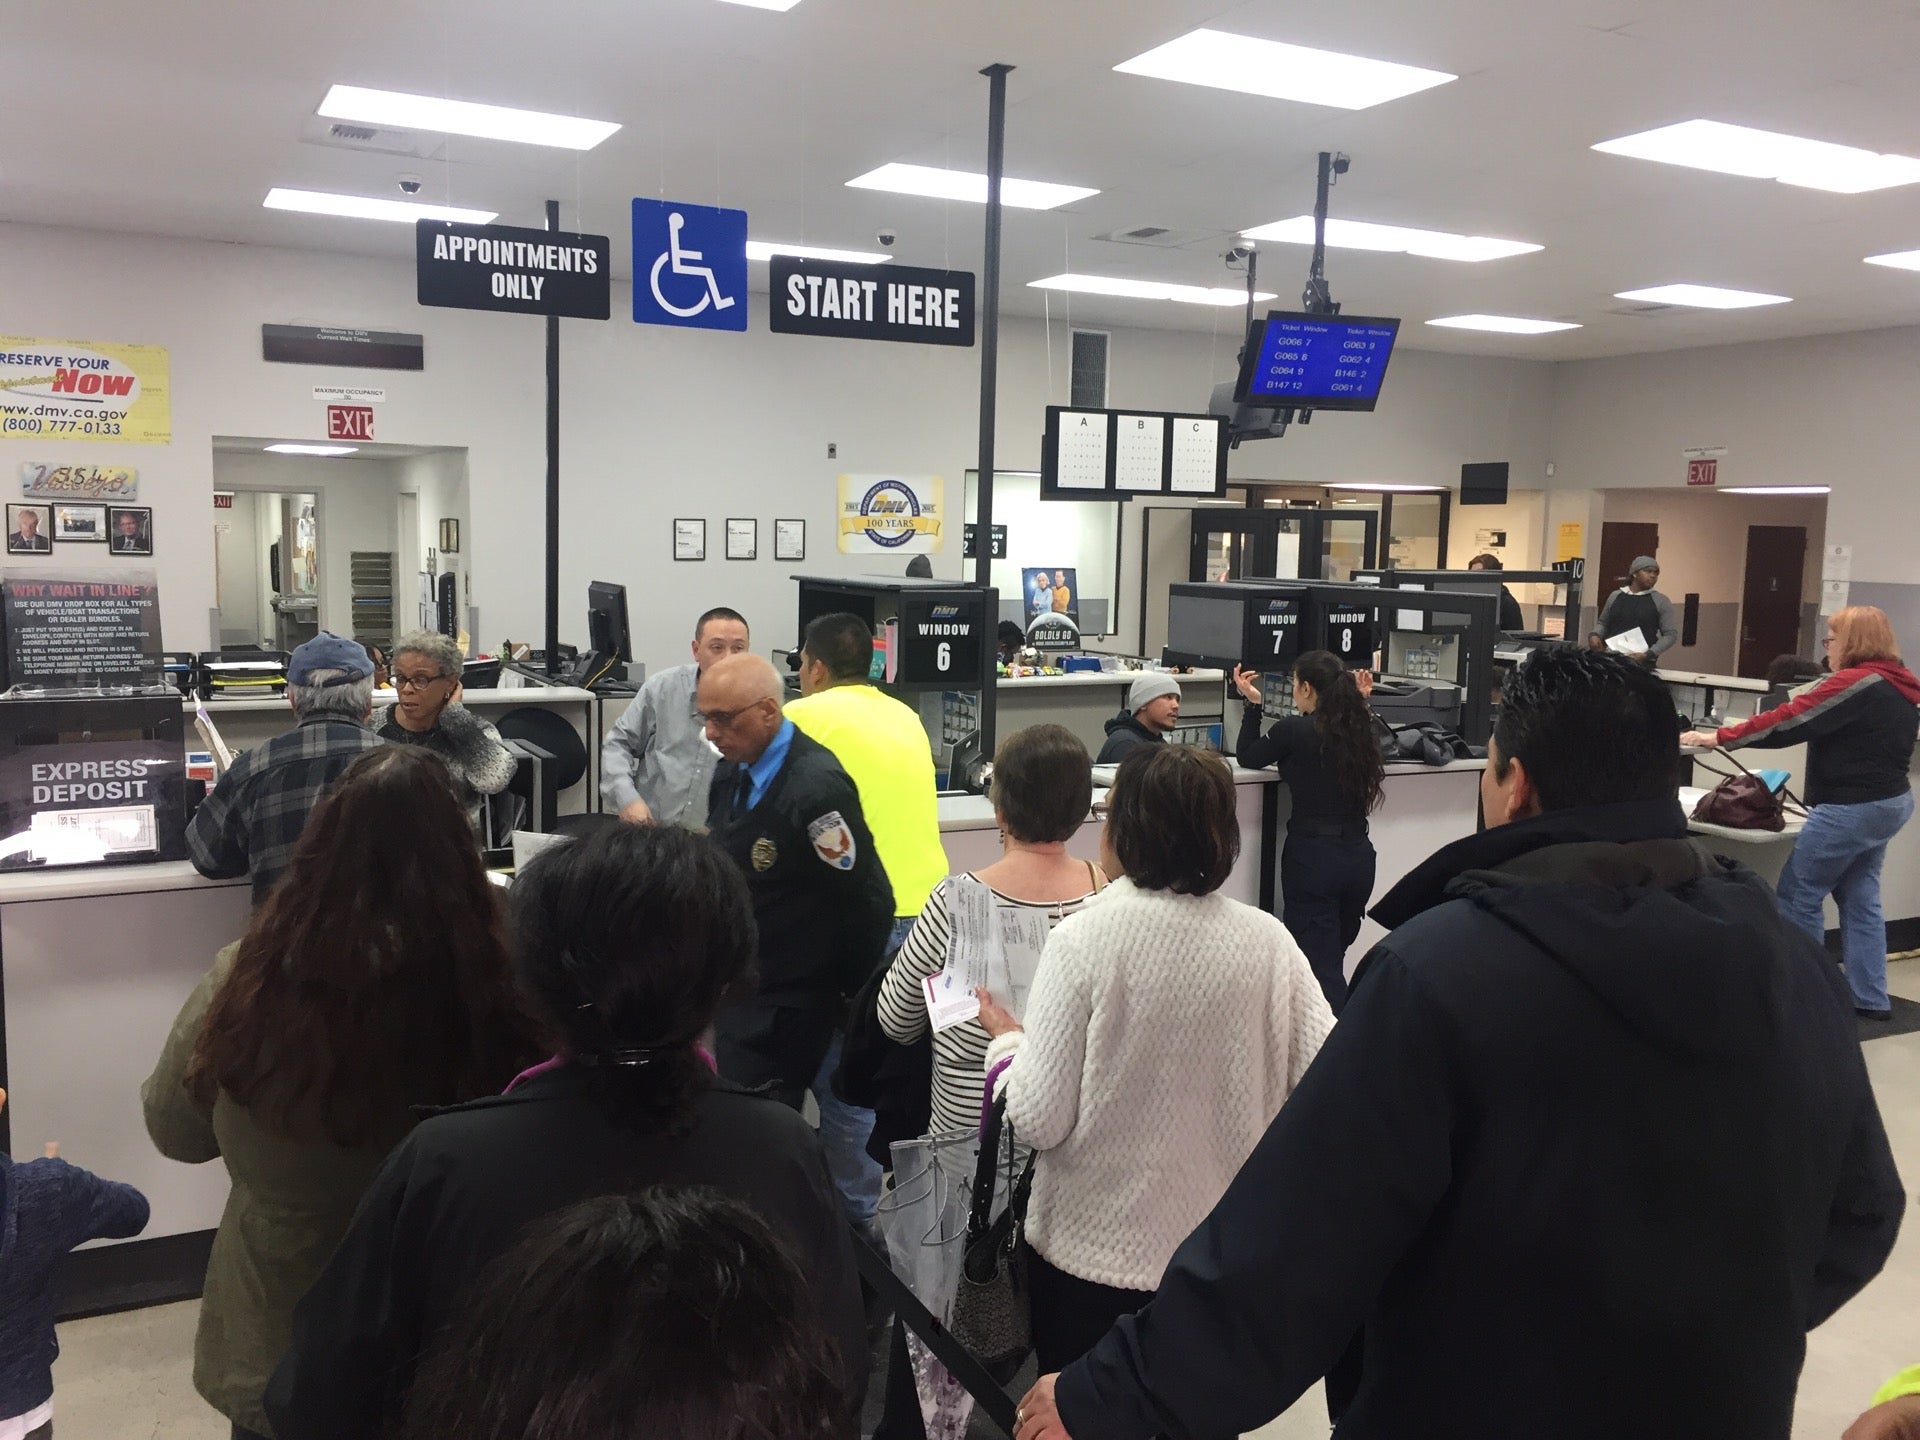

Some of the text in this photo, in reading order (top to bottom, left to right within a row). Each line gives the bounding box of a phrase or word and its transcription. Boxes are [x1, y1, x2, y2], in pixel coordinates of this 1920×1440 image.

[434, 234, 598, 274] APPOINTMENTS
[491, 273, 544, 300] ONLY
[787, 274, 960, 328] START HERE
[1304, 324, 1328, 332] Window
[0, 353, 109, 370] RESERVE YOUR
[1365, 356, 1371, 364] 4
[1360, 370, 1367, 378] 2
[1266, 381, 1302, 390] B147 12
[0, 405, 128, 421] ww.dmv.ca.gov
[3, 418, 42, 433] (800)
[50, 421, 120, 434] 777-0133
[329, 410, 371, 436] EXIT
[1080, 417, 1087, 426] A
[1138, 421, 1144, 429] B
[1193, 424, 1200, 432] C
[1688, 464, 1716, 482] EXIT
[214, 496, 230, 506] XIT
[870, 501, 909, 513] DMV
[886, 519, 914, 527] YEARS
[992, 541, 998, 554] 3
[1572, 560, 1584, 578] 10
[12, 584, 45, 596] WHY
[50, 584, 86, 597] WAIT
[90, 584, 104, 596] IN
[931, 606, 959, 618] DMV
[1329, 614, 1365, 623] WINDOW
[1259, 615, 1297, 624] WINDOW
[918, 624, 970, 635] WINDOW
[1035, 630, 1071, 640] BOLDLY GO
[1273, 630, 1283, 654] 7
[1342, 628, 1352, 652] 8
[937, 642, 950, 671] 6
[32, 759, 148, 782] EXPRESS
[33, 780, 148, 803] DEPOSIT
